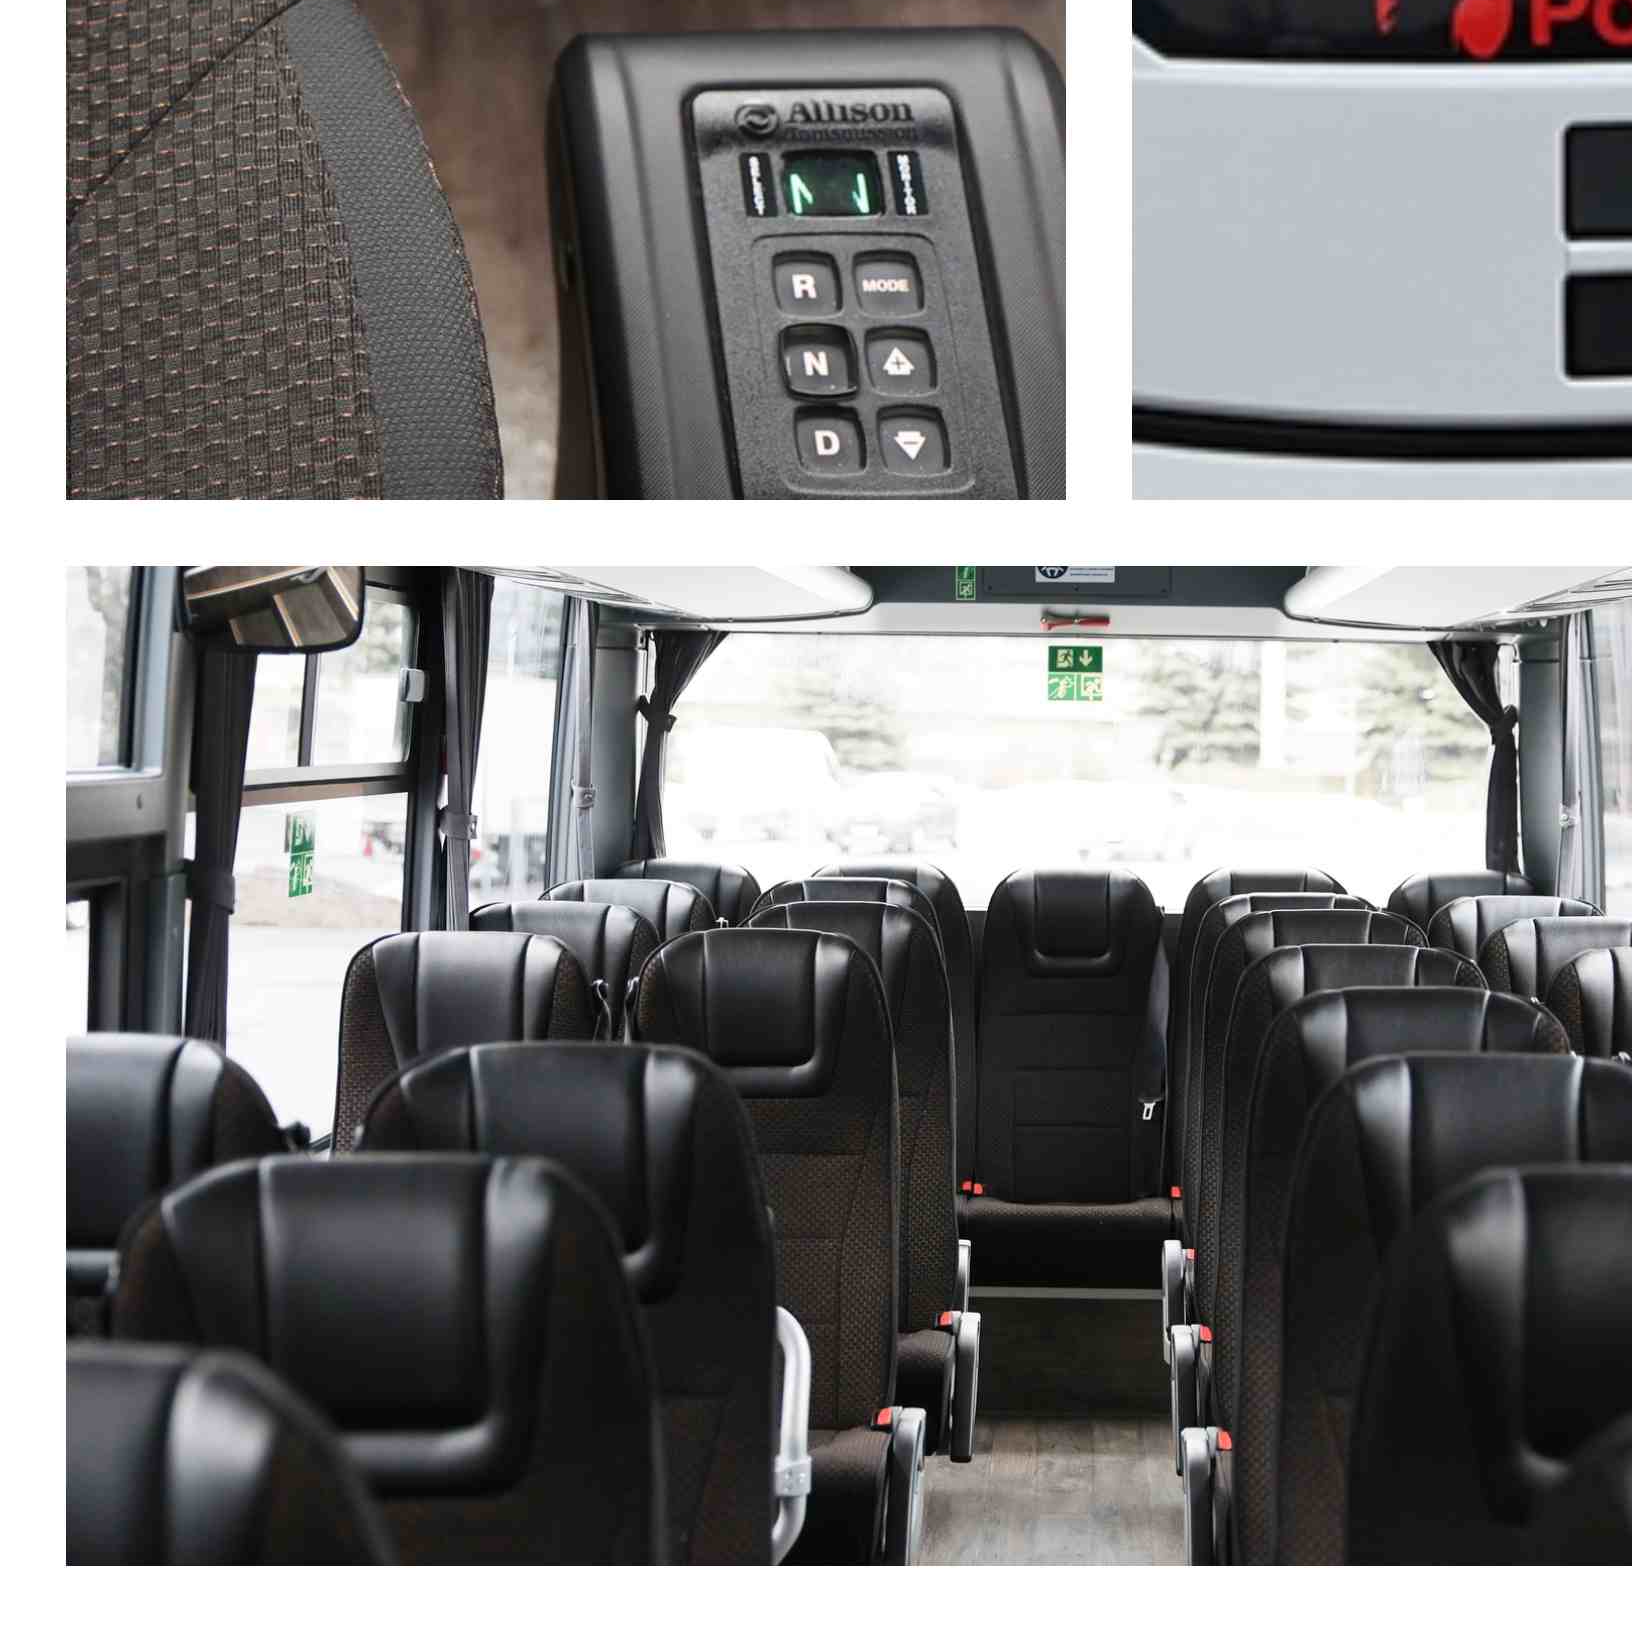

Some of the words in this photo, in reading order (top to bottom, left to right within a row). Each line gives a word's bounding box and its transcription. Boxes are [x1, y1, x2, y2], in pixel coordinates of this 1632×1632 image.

[784, 99, 914, 123] Allison
[792, 275, 816, 299] R
[862, 278, 910, 293] MODE
[804, 351, 829, 376] N
[815, 430, 840, 456] D
